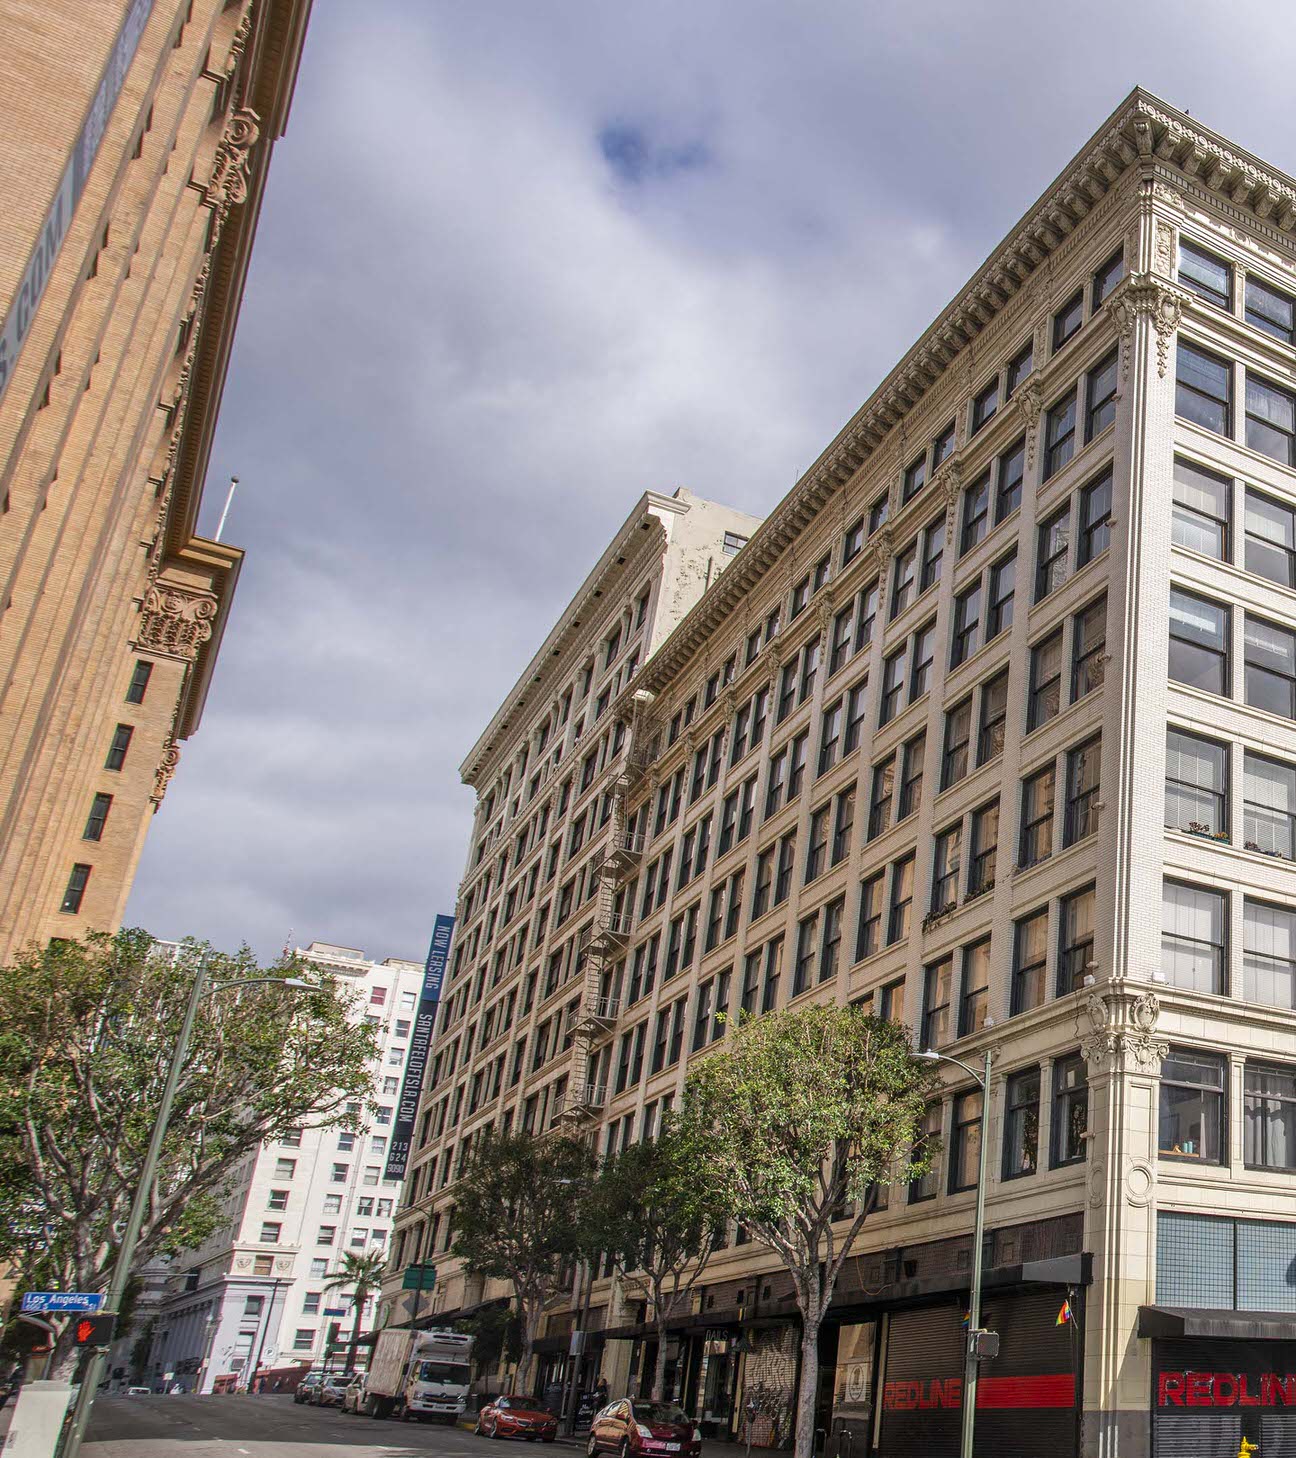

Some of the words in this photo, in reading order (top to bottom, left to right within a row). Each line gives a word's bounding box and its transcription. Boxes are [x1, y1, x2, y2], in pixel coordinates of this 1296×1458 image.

[434, 925, 451, 948] NOW
[425, 950, 446, 990] LEASING
[398, 1013, 433, 1123] SANTAFELOFTSLA.COM
[392, 1141, 409, 1152] 213
[389, 1153, 406, 1163] 624
[387, 1163, 404, 1174] 9090
[27, 1293, 46, 1304] Los
[49, 1293, 89, 1306] Angeles
[883, 1377, 962, 1411] REDLINE
